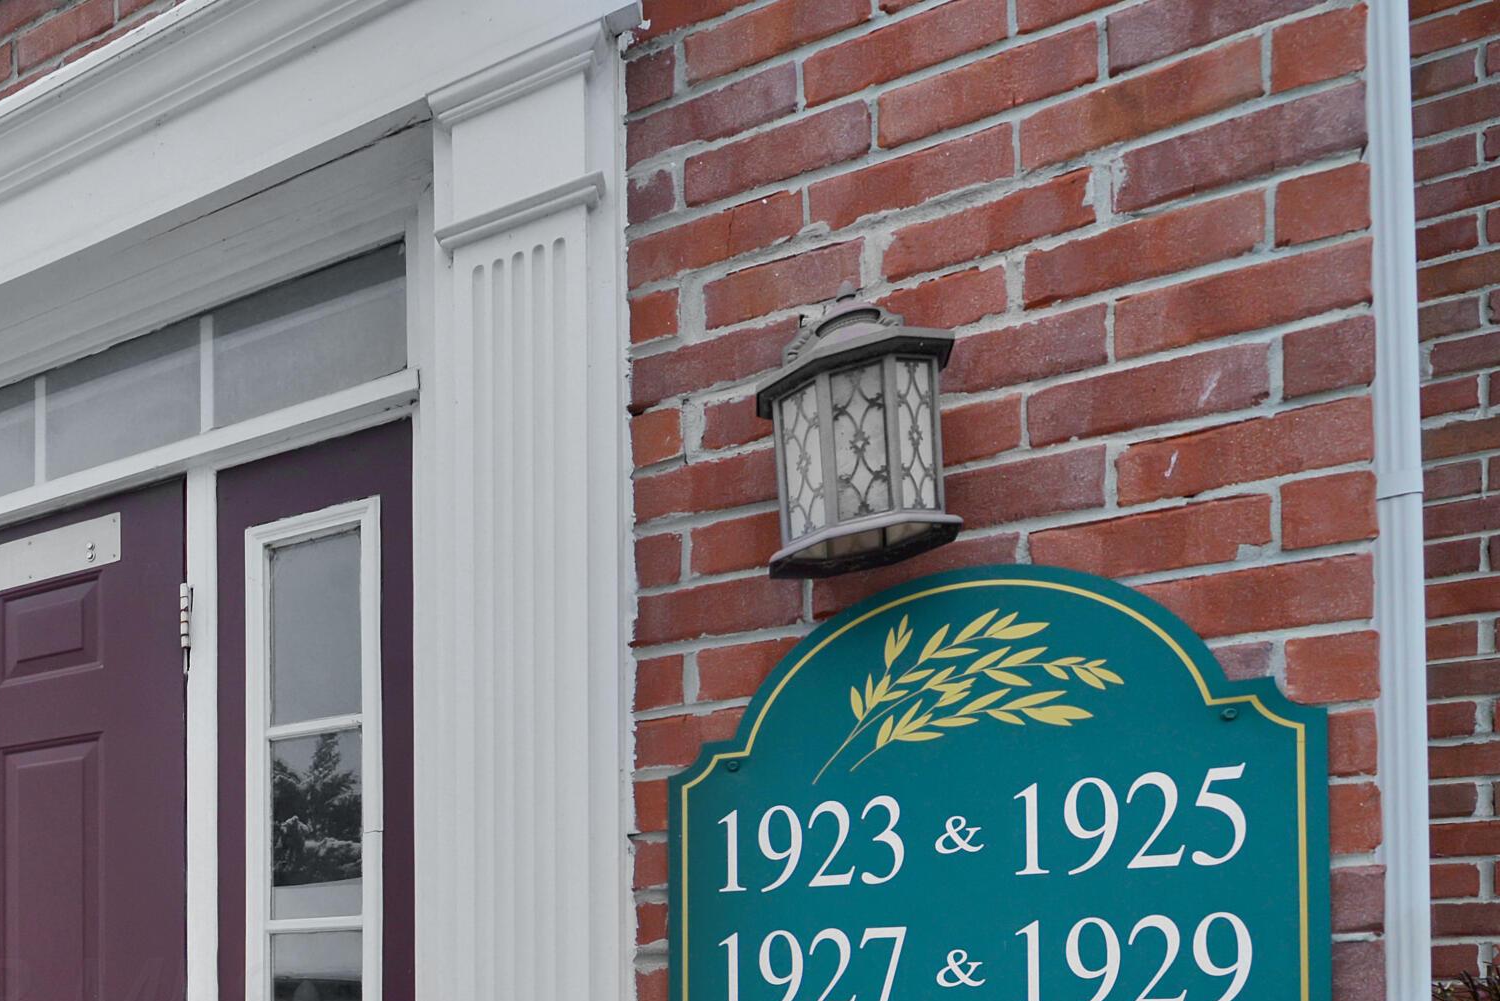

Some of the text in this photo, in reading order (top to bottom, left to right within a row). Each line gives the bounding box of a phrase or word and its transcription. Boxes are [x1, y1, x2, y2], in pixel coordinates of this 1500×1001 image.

[718, 762, 1247, 893] 1923 & 1925
[936, 949, 986, 988] &
